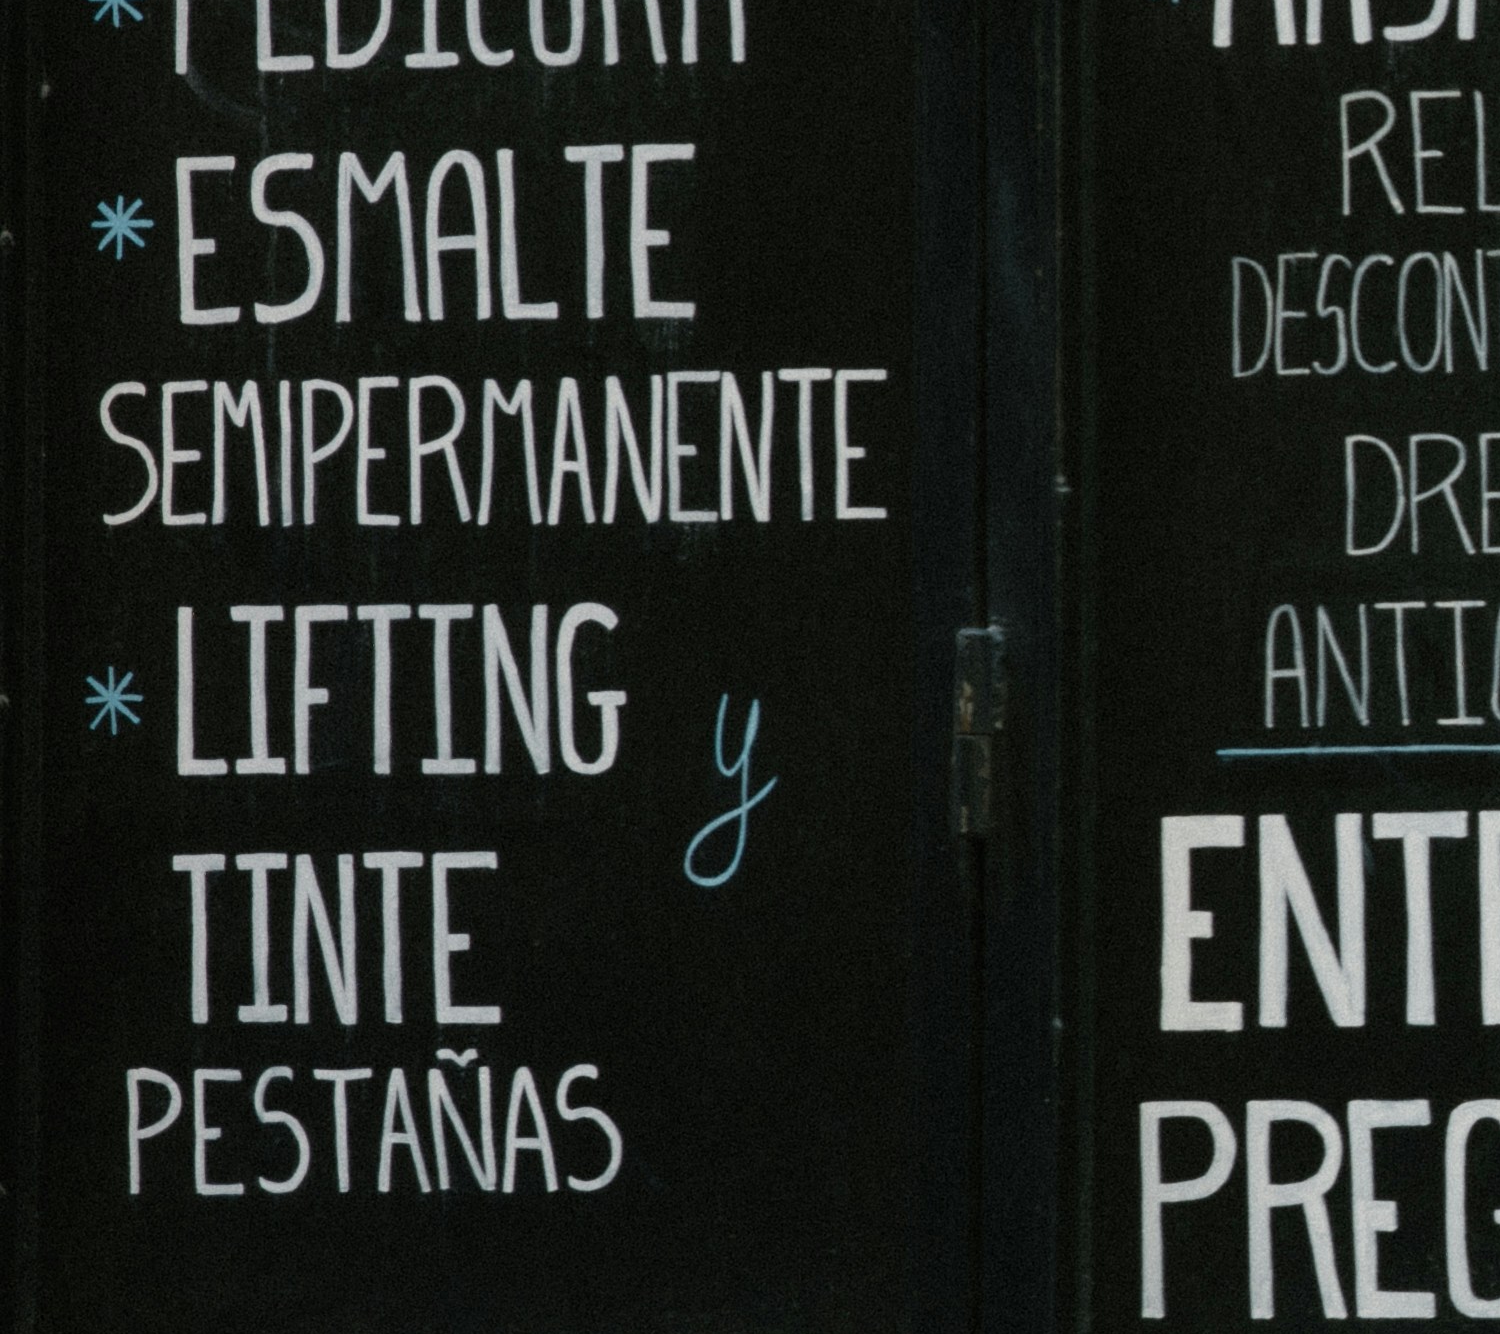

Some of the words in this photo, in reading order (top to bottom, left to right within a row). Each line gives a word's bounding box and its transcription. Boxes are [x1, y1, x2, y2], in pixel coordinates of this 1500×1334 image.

[176, 143, 695, 325] ESMALTE
[100, 368, 887, 527] SEMIPERMANENTE
[177, 602, 626, 776] LIFTING
[685, 695, 775, 886] y
[172, 851, 501, 1025] TINTE
[127, 1048, 622, 1195] PESTAÑAS
